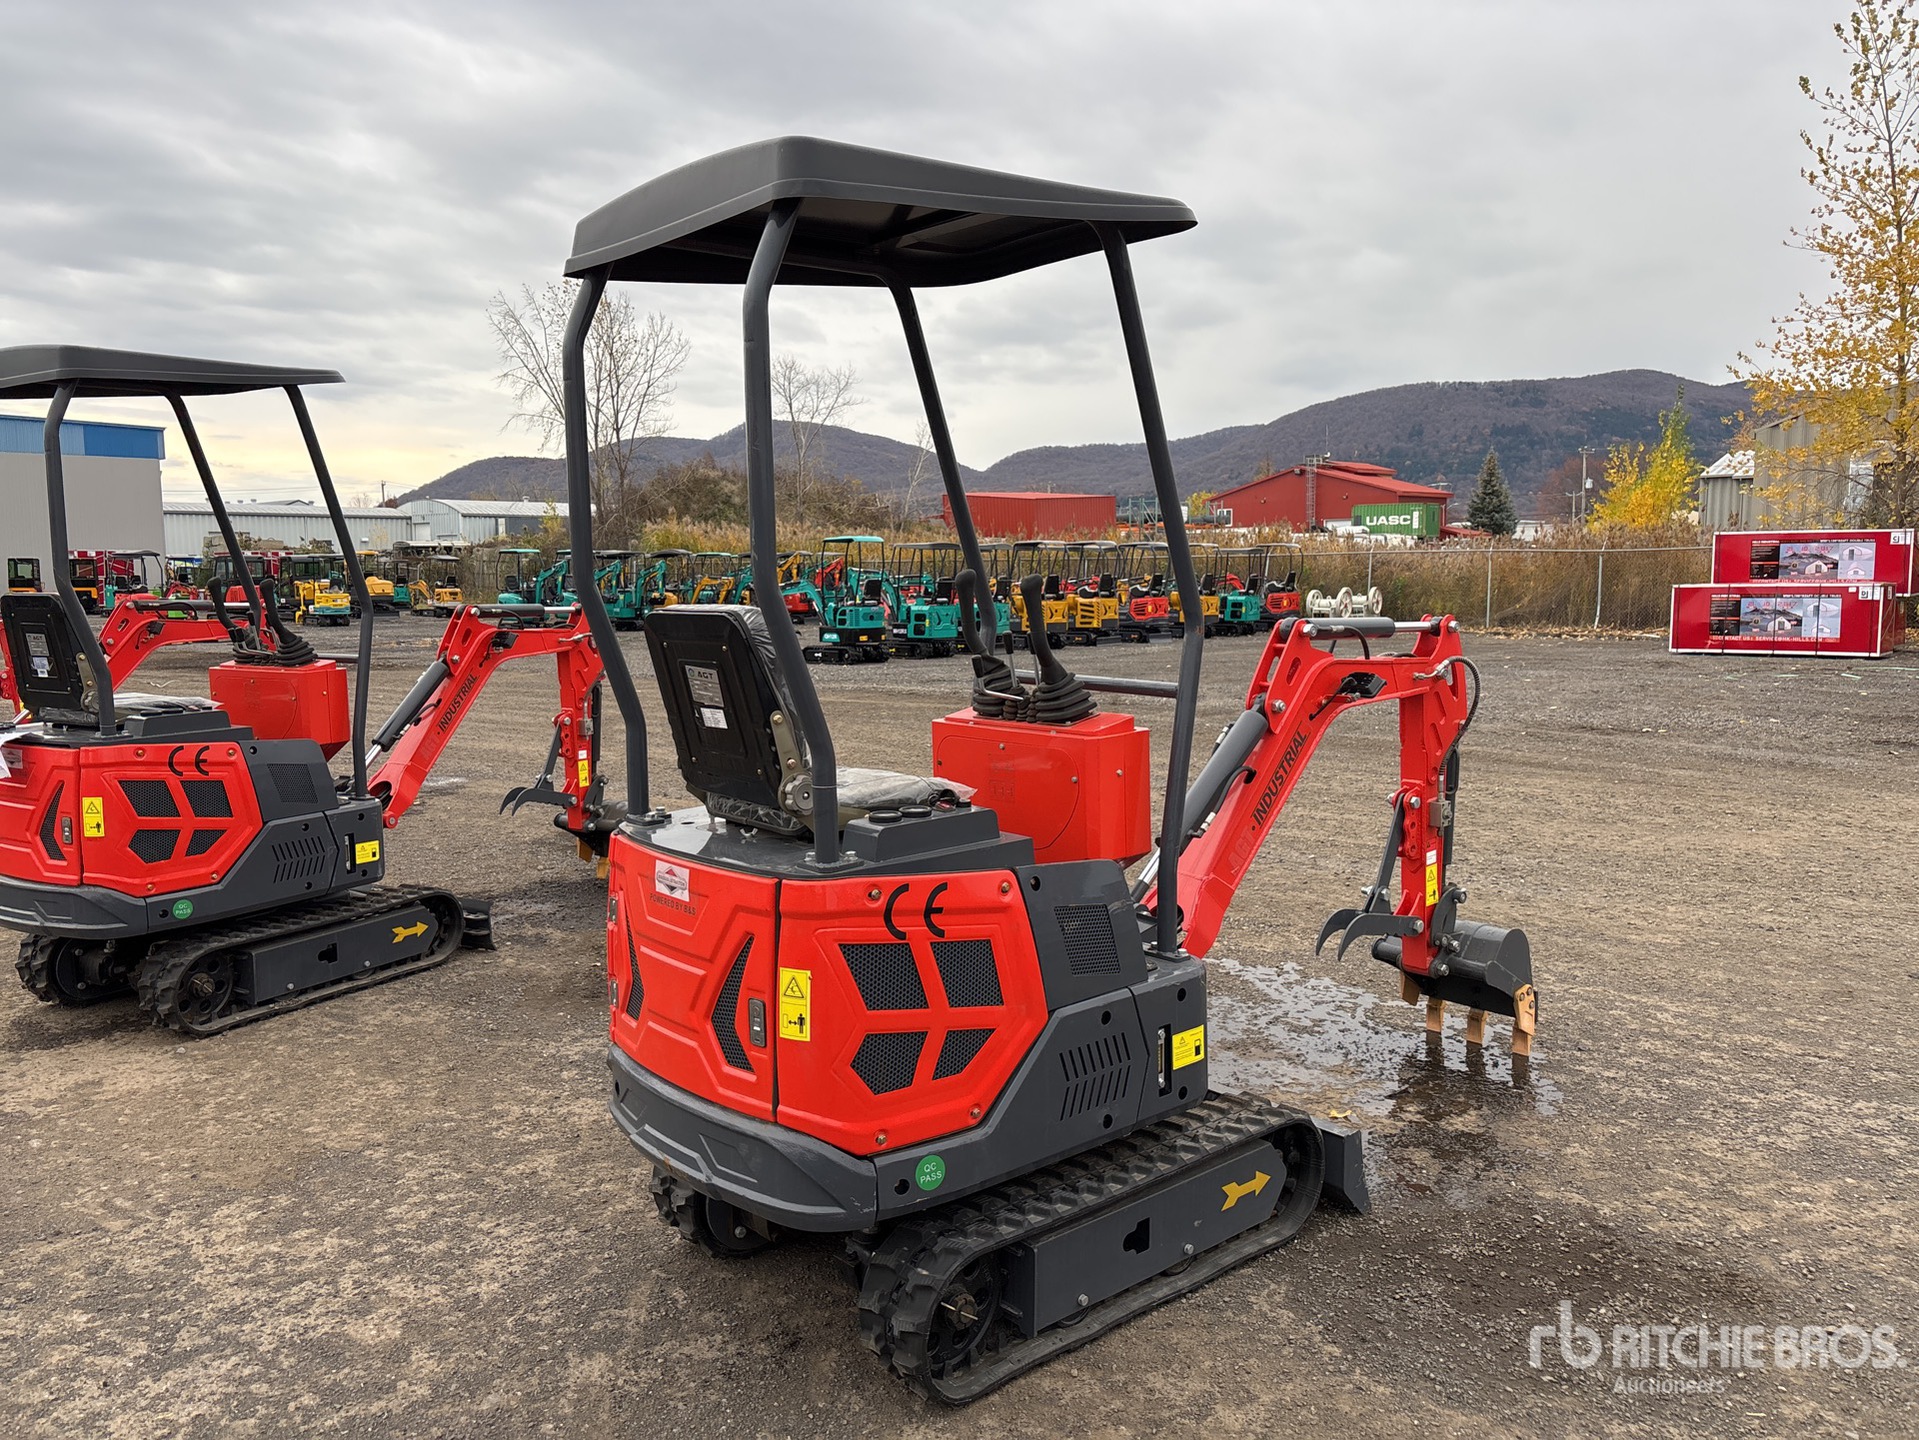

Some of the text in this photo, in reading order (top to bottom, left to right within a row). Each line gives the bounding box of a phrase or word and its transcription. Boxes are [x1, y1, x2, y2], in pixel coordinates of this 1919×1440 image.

[1366, 515, 1411, 525] UASC
[697, 671, 714, 680] AGT
[438, 674, 478, 732] INDUSTRIAL
[168, 745, 210, 777] CE
[1252, 730, 1307, 826] INDUSTRIAL
[650, 893, 675, 908] POWERED
[675, 901, 683, 911] BY
[883, 882, 948, 940] CE
[924, 1162, 937, 1173] QC
[920, 1170, 943, 1184] PASS
